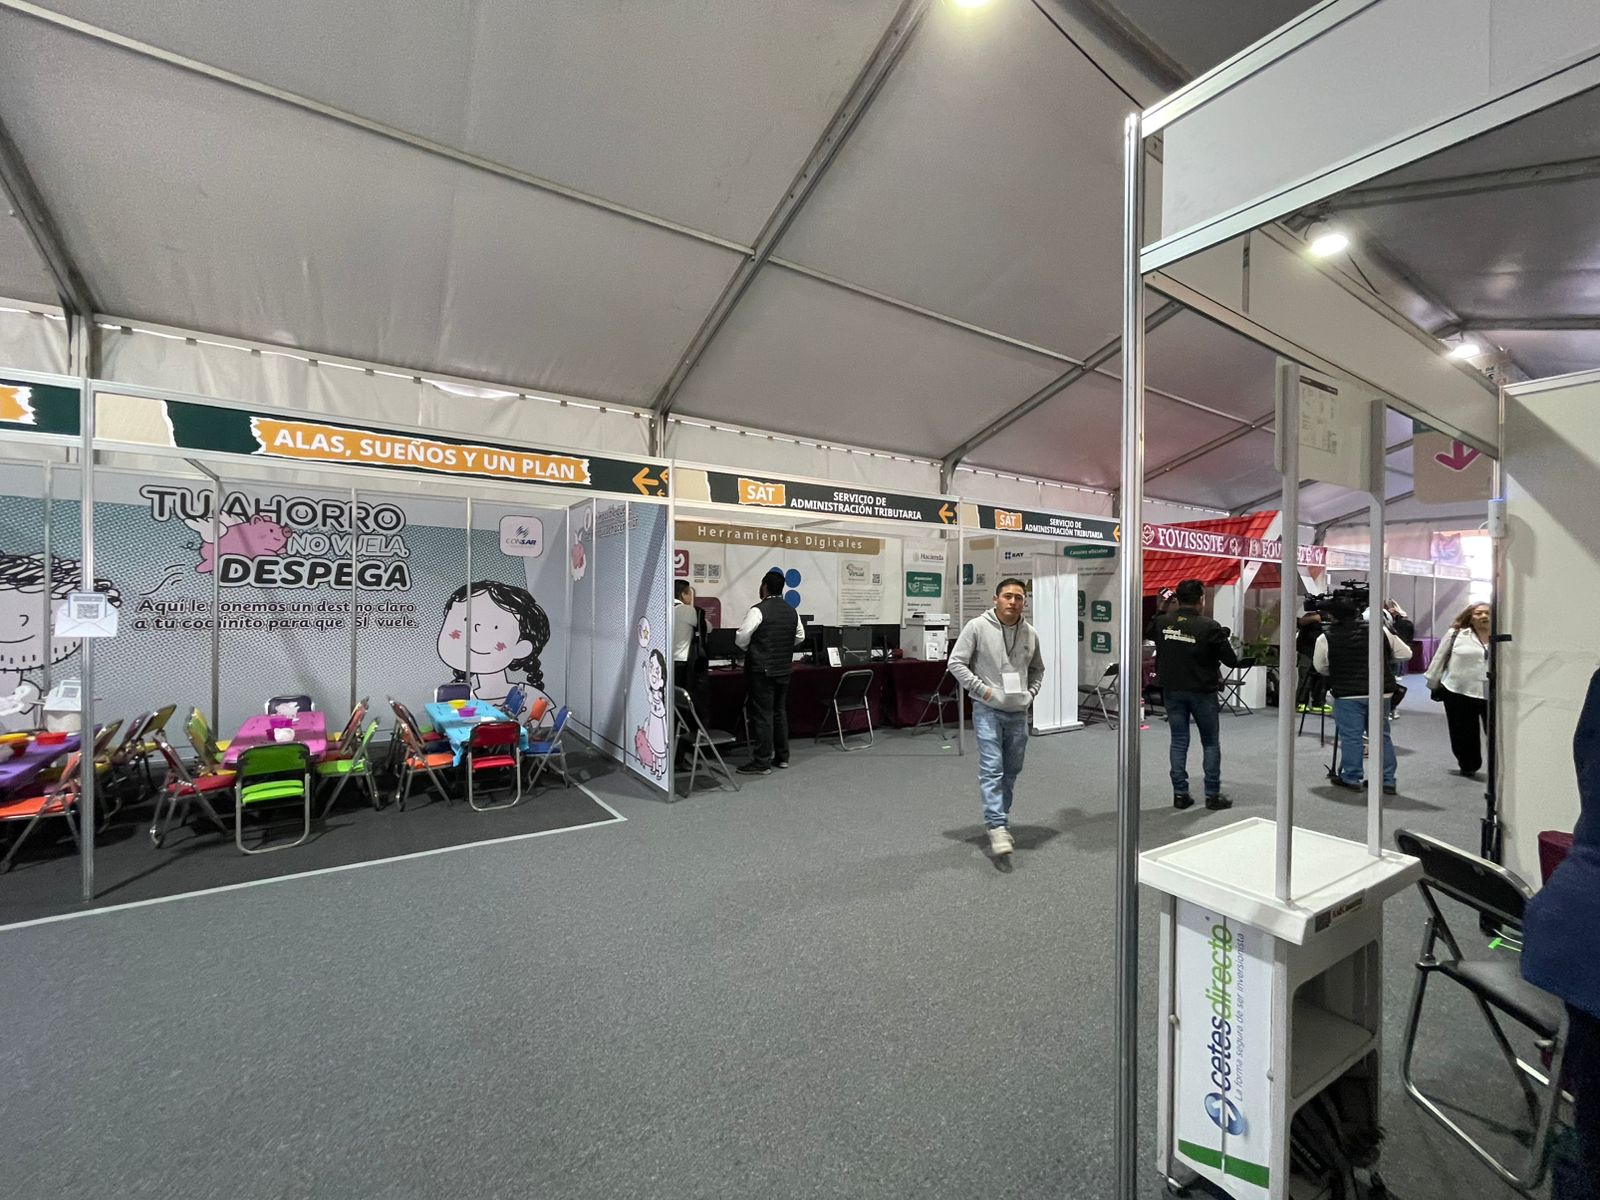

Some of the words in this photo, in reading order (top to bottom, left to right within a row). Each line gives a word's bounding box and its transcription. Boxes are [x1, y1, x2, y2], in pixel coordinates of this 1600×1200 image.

[273, 428, 352, 458] ALAS,
[359, 439, 457, 466] SUEÑOS
[461, 452, 476, 468] Y
[483, 453, 515, 473] UN
[521, 459, 575, 480] PLAN
[746, 484, 776, 503] SAT
[833, 491, 874, 506] SERVICIO
[875, 495, 887, 507] DE
[143, 486, 213, 521] TU
[222, 492, 405, 532] AHORRO
[790, 498, 873, 516] ADMINISTRACIÓN
[874, 506, 923, 521] TRIBUTARIA
[999, 513, 1017, 527] SAT
[1050, 518, 1075, 529] SERVICIO
[1075, 521, 1082, 529] DE
[697, 525, 800, 545] Herramientas
[805, 535, 864, 551] Digitales
[1024, 523, 1074, 536] ADMINISTRACIÓN
[1074, 528, 1104, 539] TRIBUTARIA
[1158, 527, 1224, 553] FOVISSSTE
[288, 534, 328, 555] NO
[505, 538, 537, 546] CONSAR
[219, 556, 409, 590] DESPEGA
[139, 599, 186, 616] Aquí
[191, 599, 207, 612] le
[214, 602, 286, 614] onemos
[292, 602, 311, 612] un
[317, 600, 372, 612] destno
[377, 601, 414, 612] claro
[134, 620, 147, 629] a
[155, 618, 175, 629] tu
[268, 620, 311, 632] para
[315, 620, 343, 631] que
[355, 613, 367, 628] SÍ
[377, 616, 417, 628] vuele.
[1234, 932, 1245, 992] inversionista
[1206, 924, 1233, 1092] cetesdirecto
[1235, 994, 1245, 1008] ser
[1234, 1008, 1244, 1024] de
[1235, 1026, 1245, 1057] segura
[1234, 1058, 1244, 1089] forma
[1234, 1089, 1243, 1102] La
